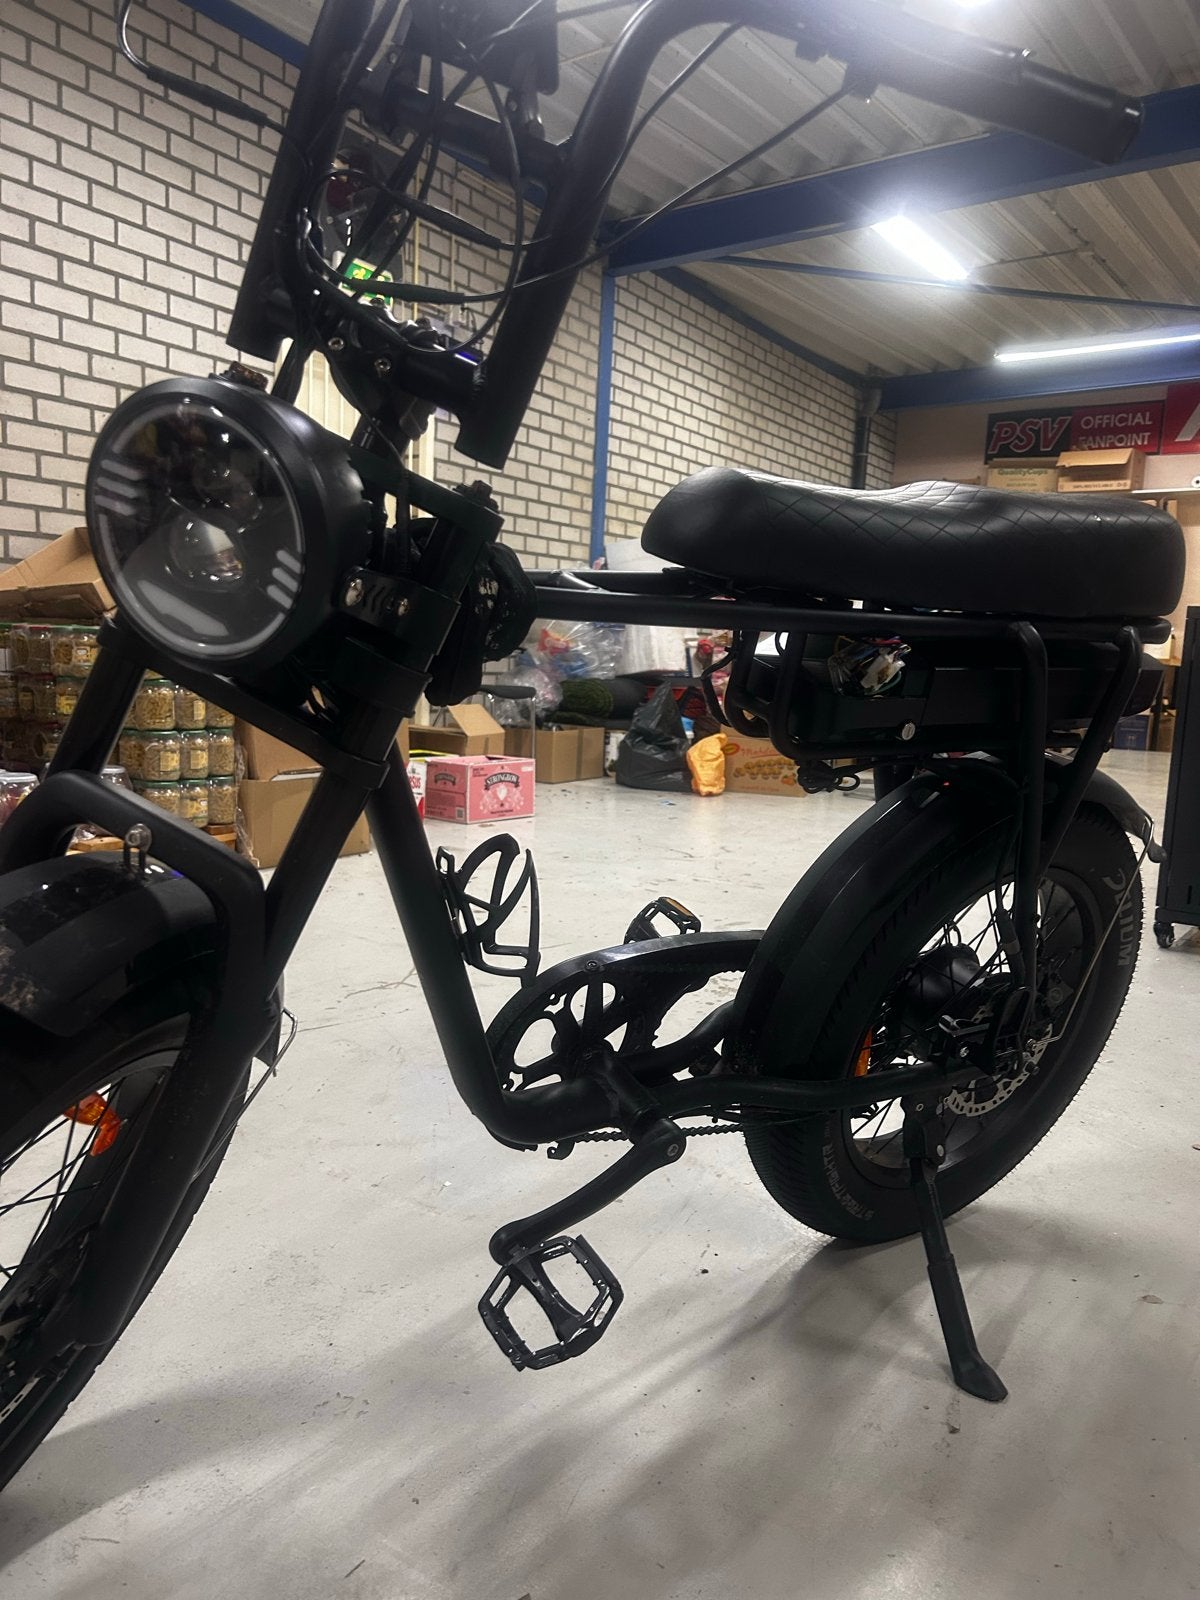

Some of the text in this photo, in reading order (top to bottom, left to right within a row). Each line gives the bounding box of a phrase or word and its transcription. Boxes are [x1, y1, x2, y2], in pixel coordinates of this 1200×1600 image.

[1080, 412, 1153, 430] OFFICIAL
[987, 416, 1072, 454] PSV
[1079, 432, 1150, 449] FANPOINT
